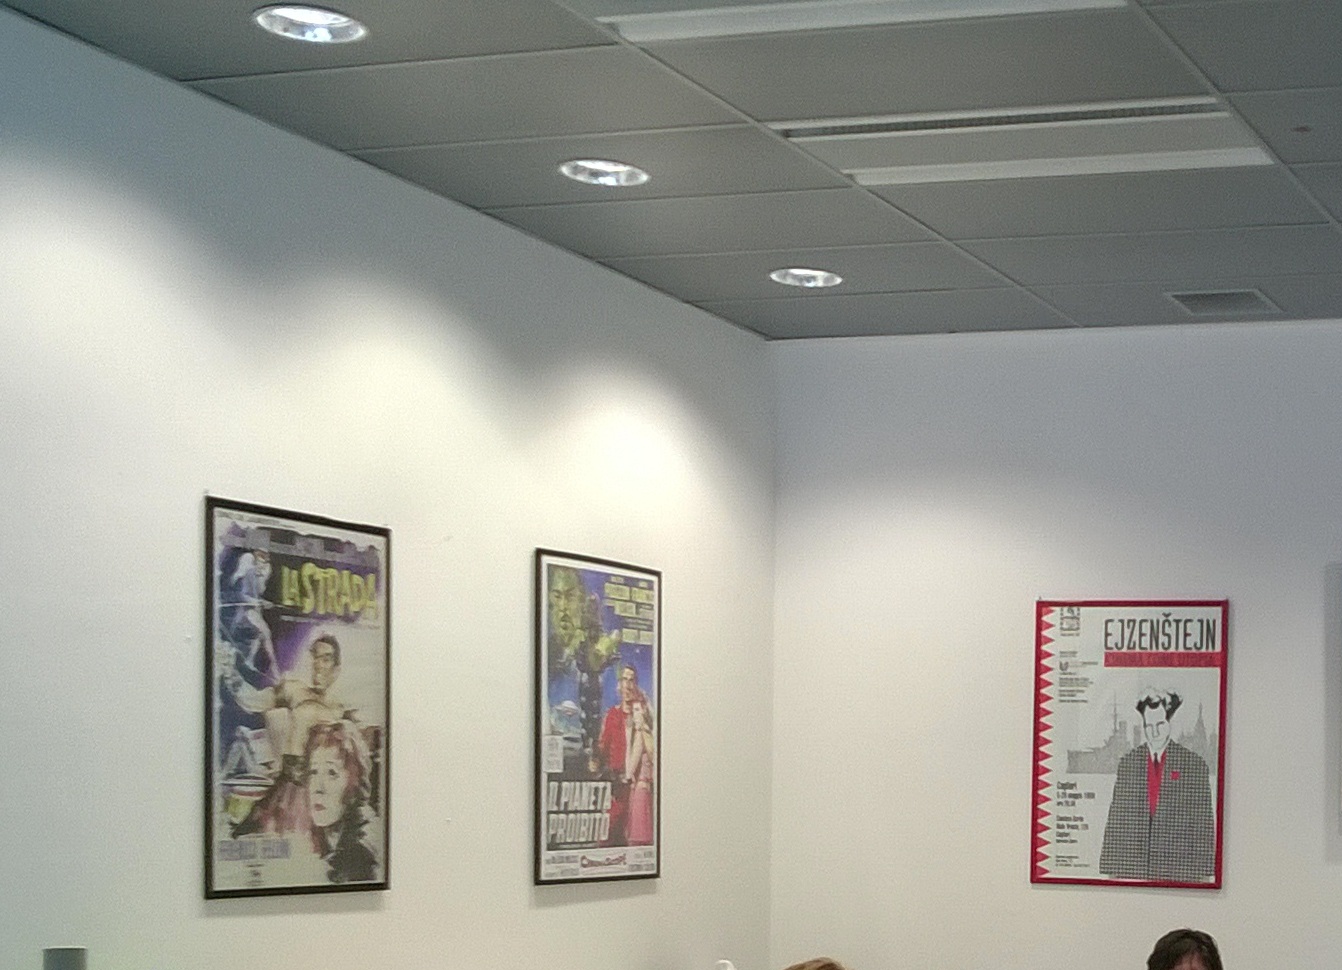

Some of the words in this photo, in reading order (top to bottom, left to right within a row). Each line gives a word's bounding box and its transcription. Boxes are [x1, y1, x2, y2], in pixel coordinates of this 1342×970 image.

[301, 562, 376, 618] STRADA
[1104, 611, 1216, 651] EJZENŠTEJN
[547, 812, 611, 844] PROIBITO
